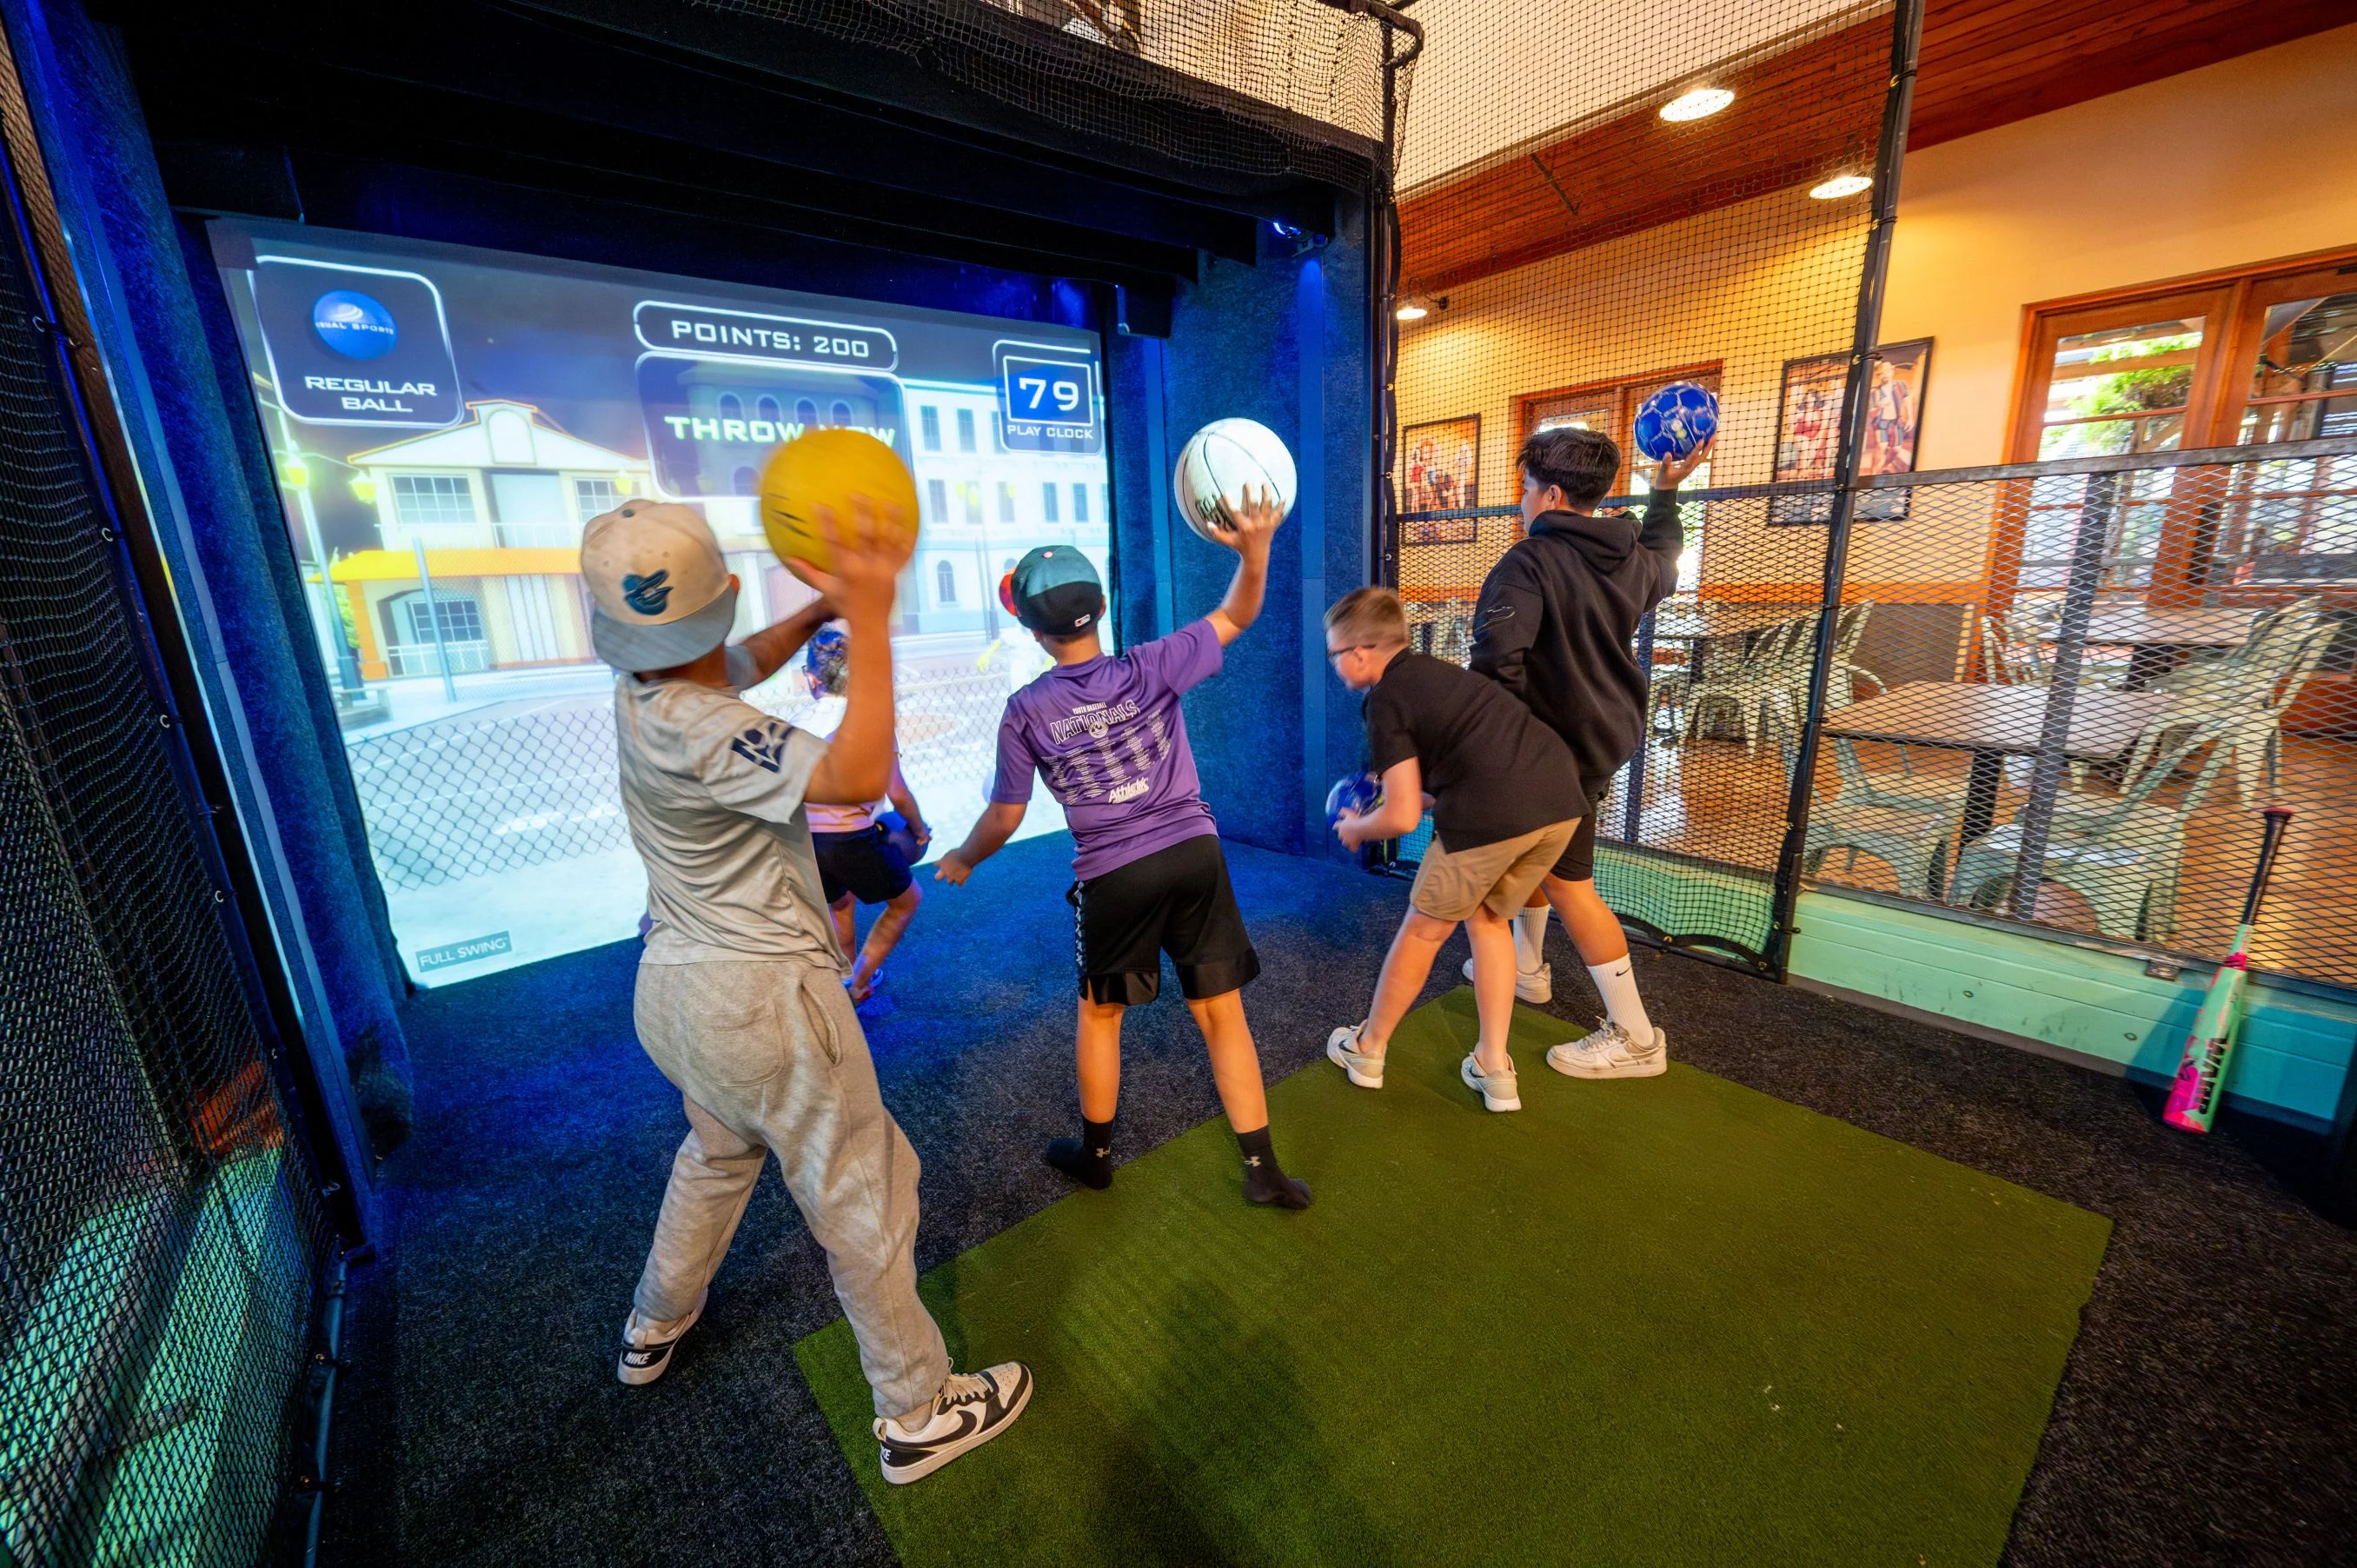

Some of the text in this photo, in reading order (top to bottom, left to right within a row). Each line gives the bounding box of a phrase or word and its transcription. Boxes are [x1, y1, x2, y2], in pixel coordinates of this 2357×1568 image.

[672, 320, 869, 358] POINTS: 200
[305, 375, 437, 396] REGULAR
[1019, 377, 1079, 411] 79
[341, 396, 414, 413] BALL
[664, 415, 805, 443] THROW
[1007, 424, 1093, 439] PLAY CLOCK
[1050, 699, 1141, 746] NATIONALS
[419, 938, 507, 967] FULL SWING
[625, 1352, 652, 1365] NIKE
